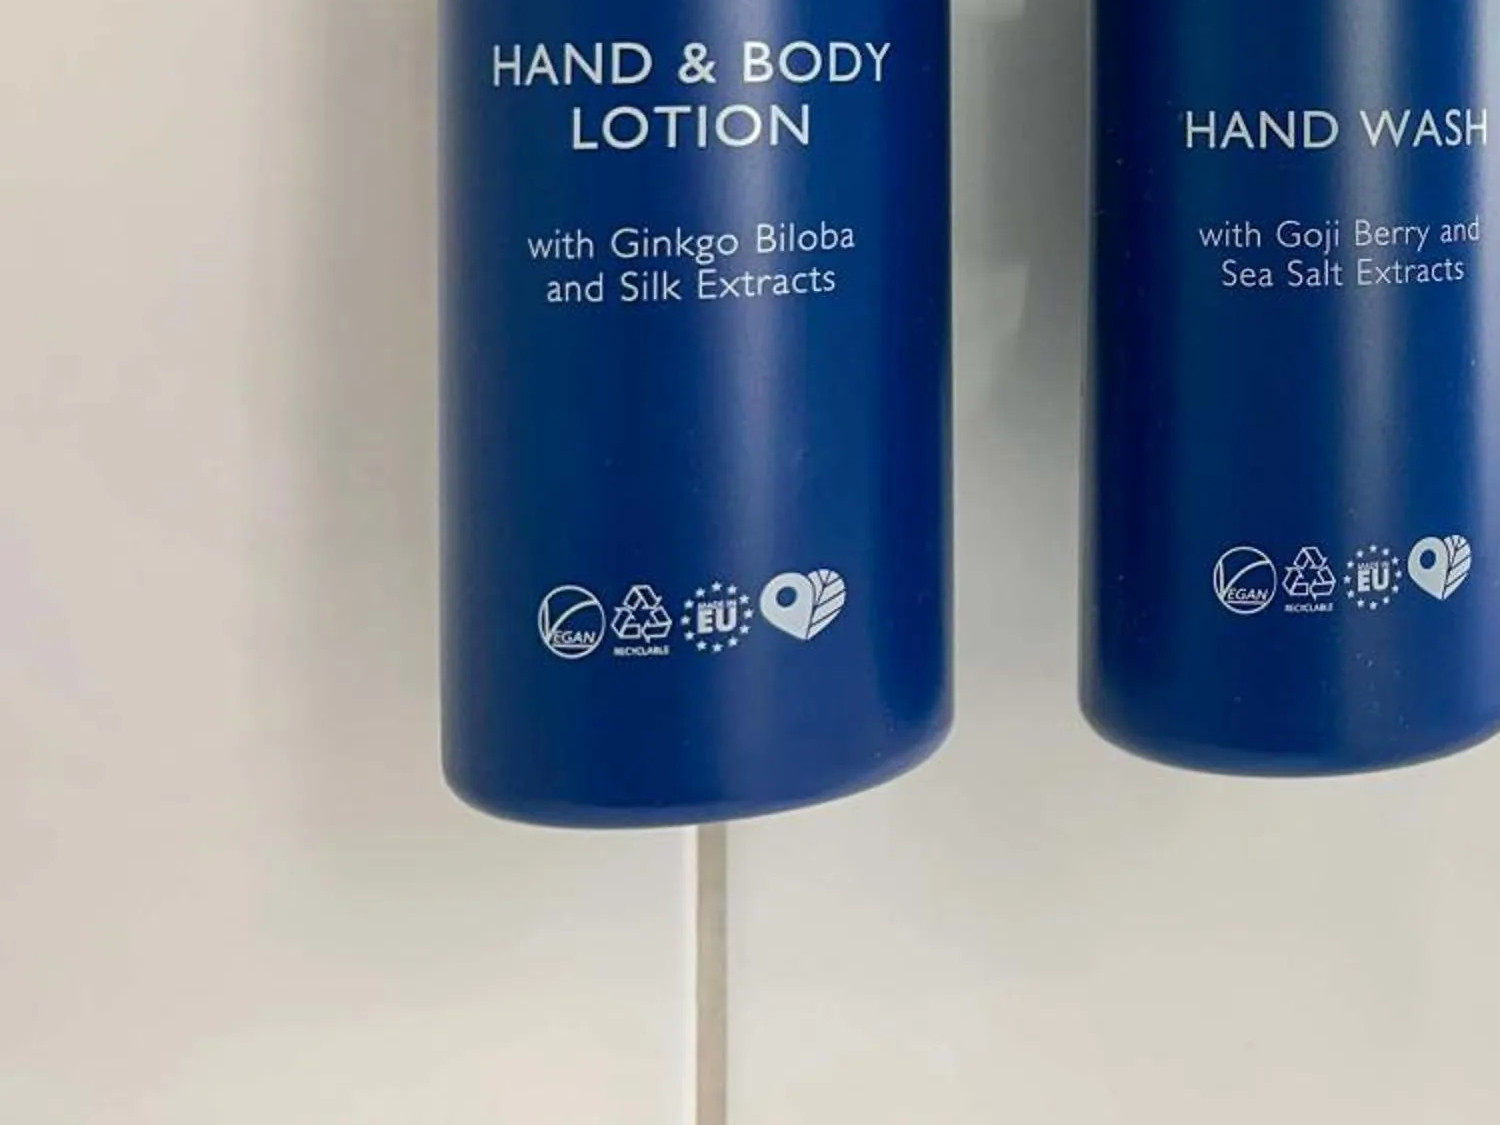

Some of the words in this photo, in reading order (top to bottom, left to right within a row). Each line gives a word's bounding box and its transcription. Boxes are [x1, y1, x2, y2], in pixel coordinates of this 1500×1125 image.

[493, 43, 653, 86] HAND
[677, 43, 716, 84] &
[743, 41, 891, 83] BODY
[572, 104, 810, 150] LOTION
[1185, 110, 1339, 149] HAND
[1359, 108, 1487, 148] WASH
[527, 229, 594, 259] with
[611, 228, 739, 264] Ginkgo
[757, 221, 855, 253] Biloba
[1199, 221, 1260, 248] with
[1276, 220, 1340, 254] Goji
[1355, 219, 1430, 251] Berry
[1440, 215, 1481, 243] and
[547, 271, 603, 302] and
[621, 271, 681, 301] Silk
[698, 267, 835, 300] Extracts
[1221, 260, 1274, 288] Sea
[1287, 259, 1343, 287] Salt
[1357, 256, 1465, 286] Extracts
[1357, 568, 1390, 592] EU
[697, 607, 738, 634] EU
